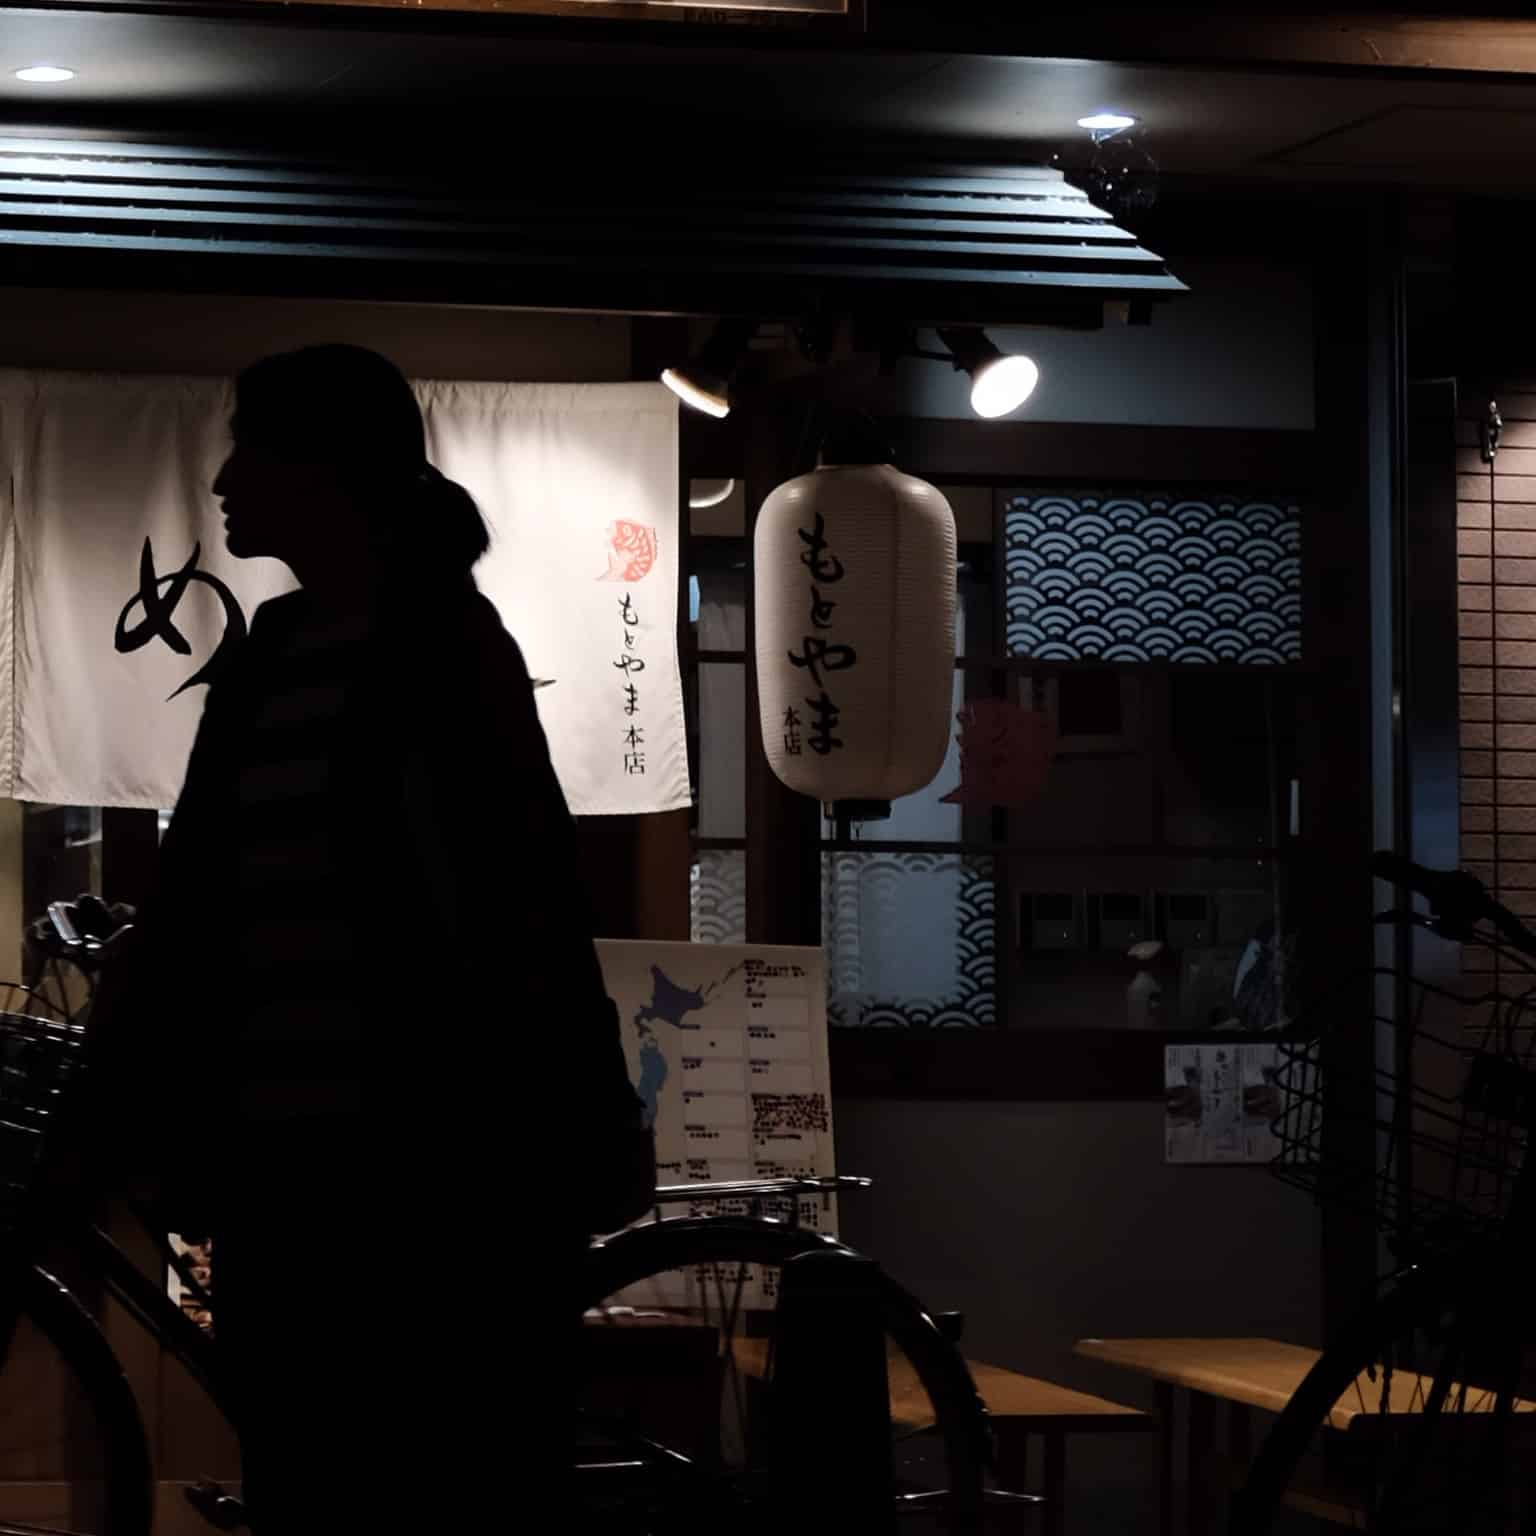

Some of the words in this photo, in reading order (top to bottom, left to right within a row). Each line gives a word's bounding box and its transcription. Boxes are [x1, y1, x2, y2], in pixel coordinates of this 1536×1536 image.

[789, 512, 857, 755] もとやま
[784, 706, 802, 756] 本店
